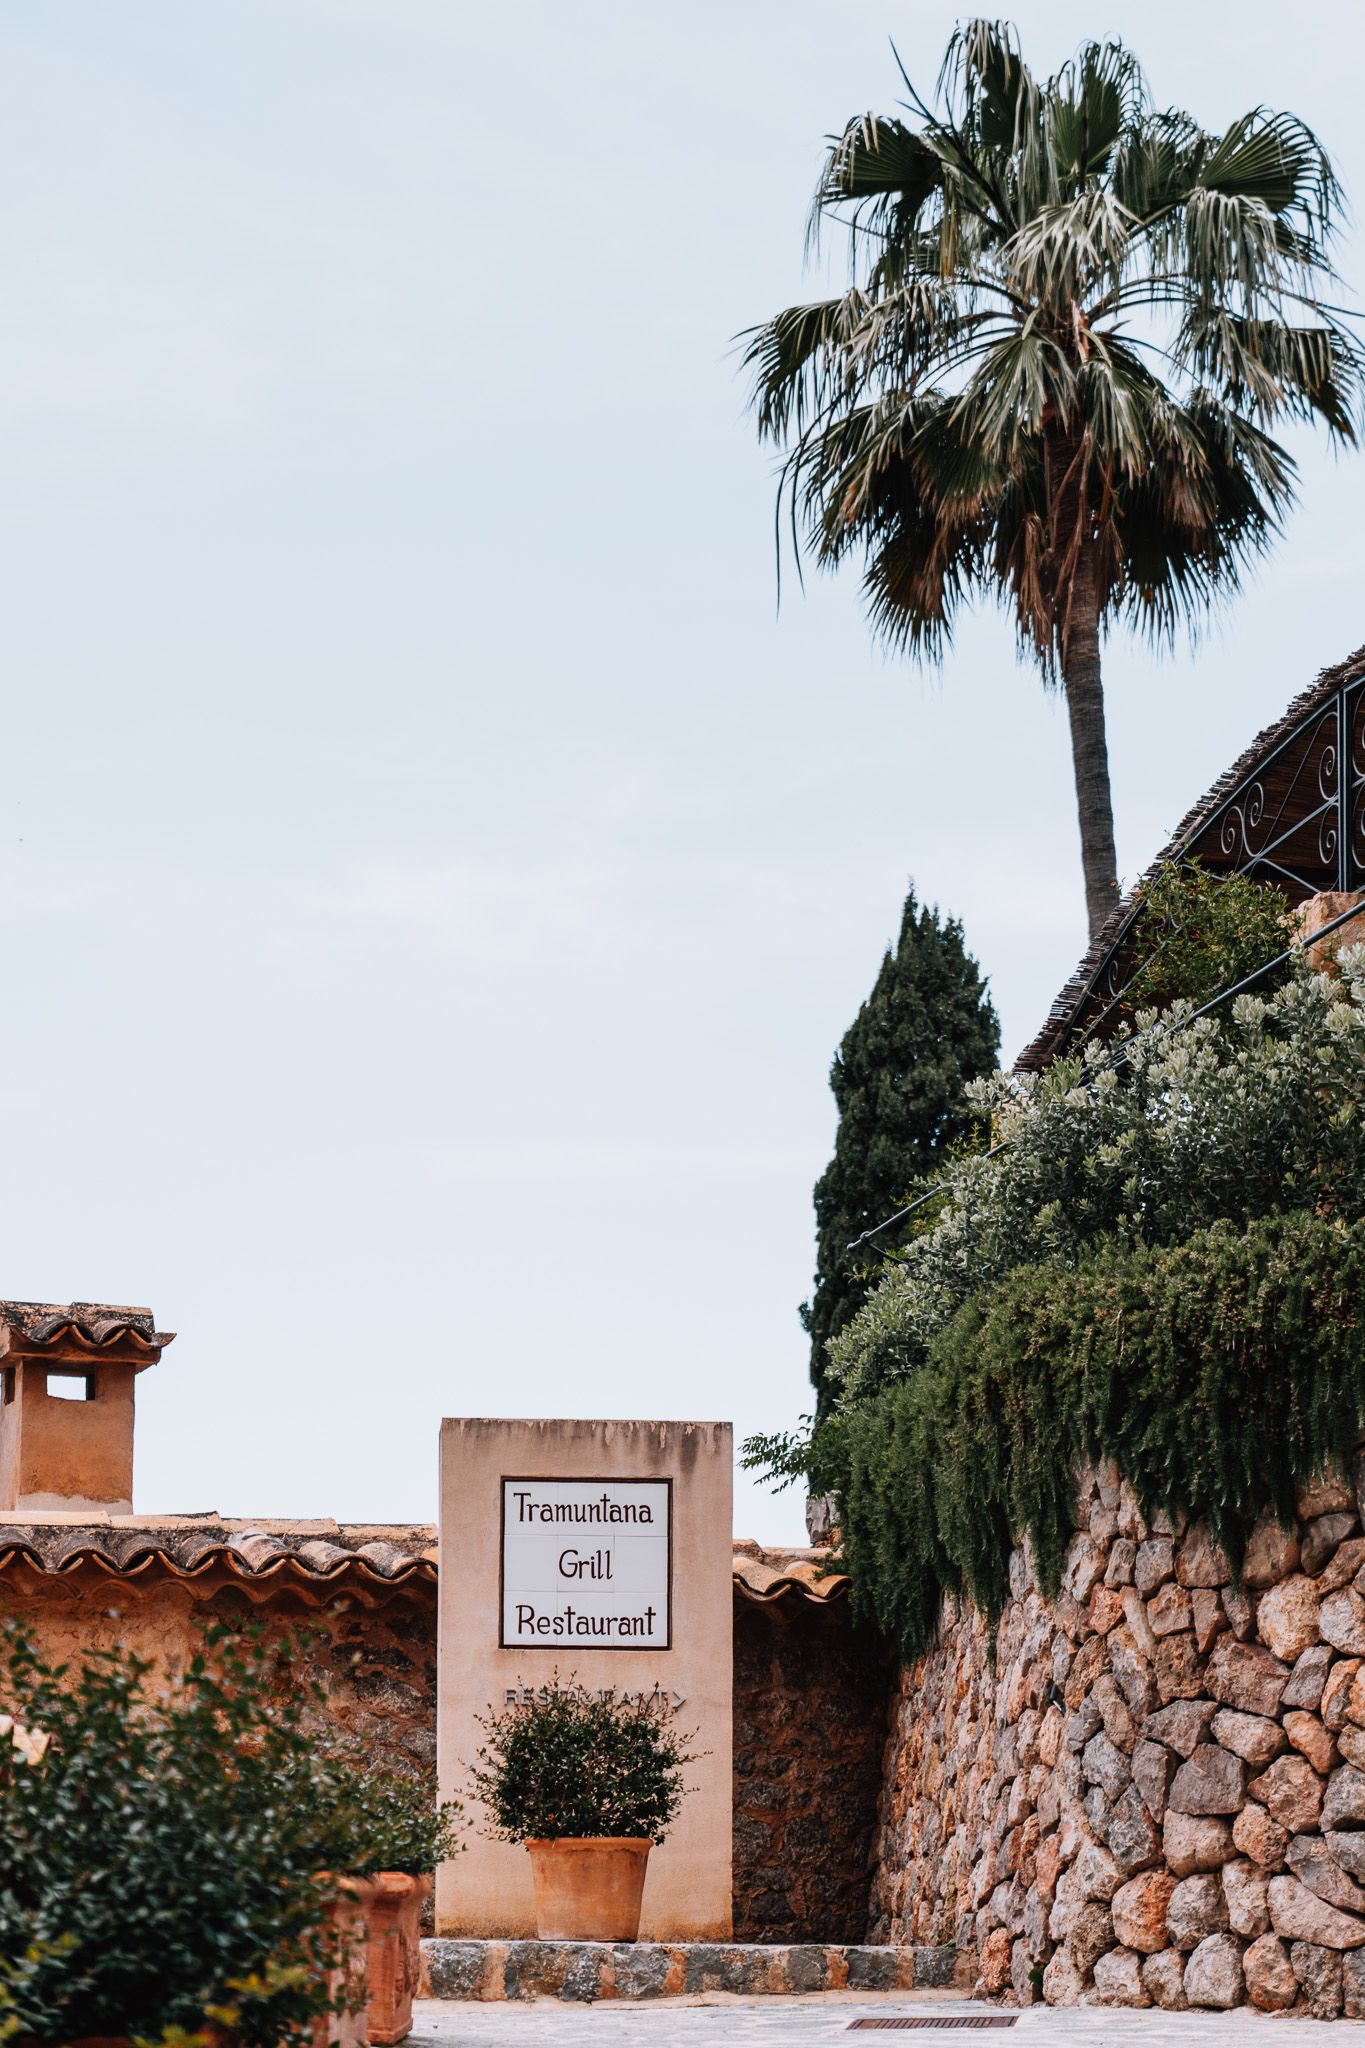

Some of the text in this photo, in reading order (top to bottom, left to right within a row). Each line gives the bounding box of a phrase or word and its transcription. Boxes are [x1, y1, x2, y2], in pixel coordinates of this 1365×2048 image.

[513, 1492, 654, 1524] Tramuntana
[558, 1549, 614, 1580] Grill
[515, 1604, 657, 1636] Restaurant
